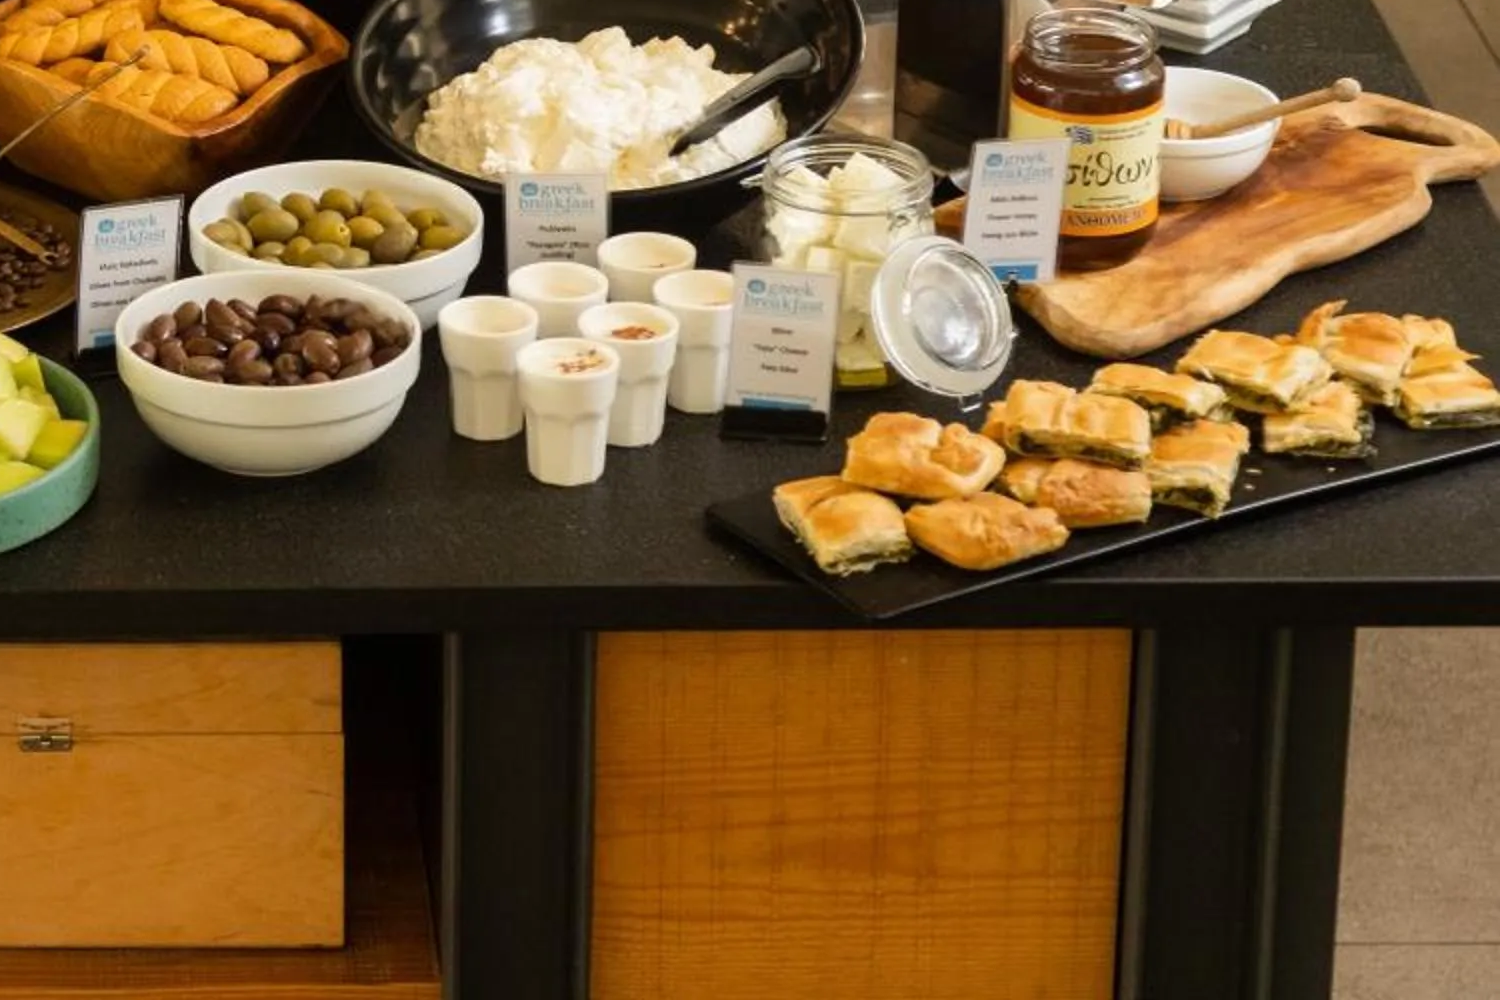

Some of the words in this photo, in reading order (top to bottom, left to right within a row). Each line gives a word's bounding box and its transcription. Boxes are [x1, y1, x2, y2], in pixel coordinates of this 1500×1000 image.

[541, 182, 585, 199] greek
[520, 197, 595, 213] breakfast
[116, 213, 156, 232] greek
[95, 229, 166, 246] breakfast
[769, 279, 814, 296] greek
[745, 293, 824, 314] breakfast
